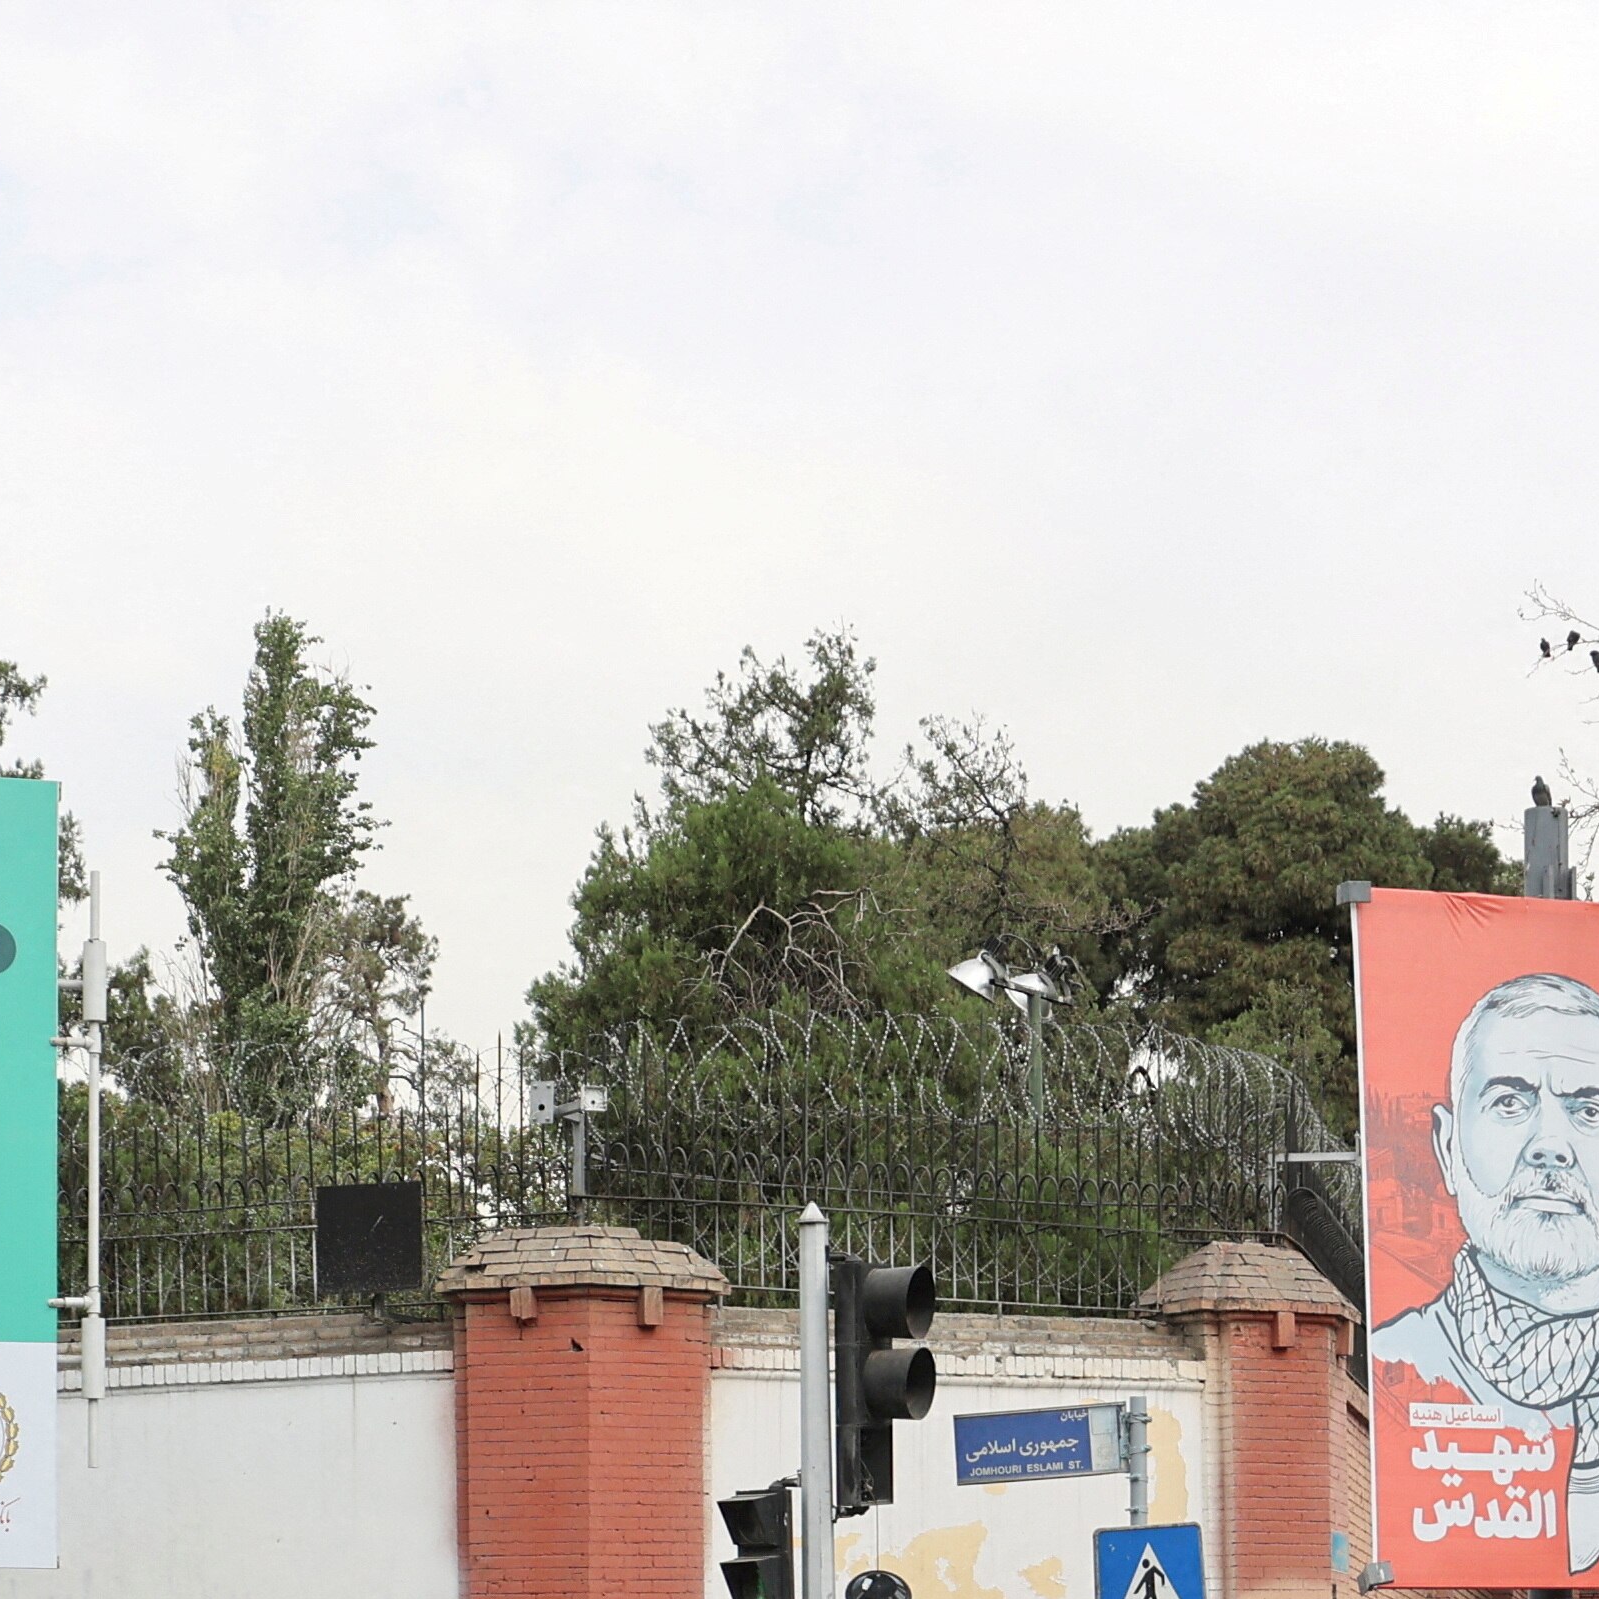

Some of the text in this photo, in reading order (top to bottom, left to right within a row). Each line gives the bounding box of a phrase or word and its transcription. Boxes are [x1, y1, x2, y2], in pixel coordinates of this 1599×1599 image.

[1060, 1409, 1089, 1422] خیابان
[1412, 1407, 1501, 1426] اسماعیل هنیه
[965, 1438, 1080, 1463] جمهوری اسلامی
[969, 1460, 1084, 1477] JOMHOURI ESLAMI ST.
[1412, 1485, 1557, 1543] القدس
